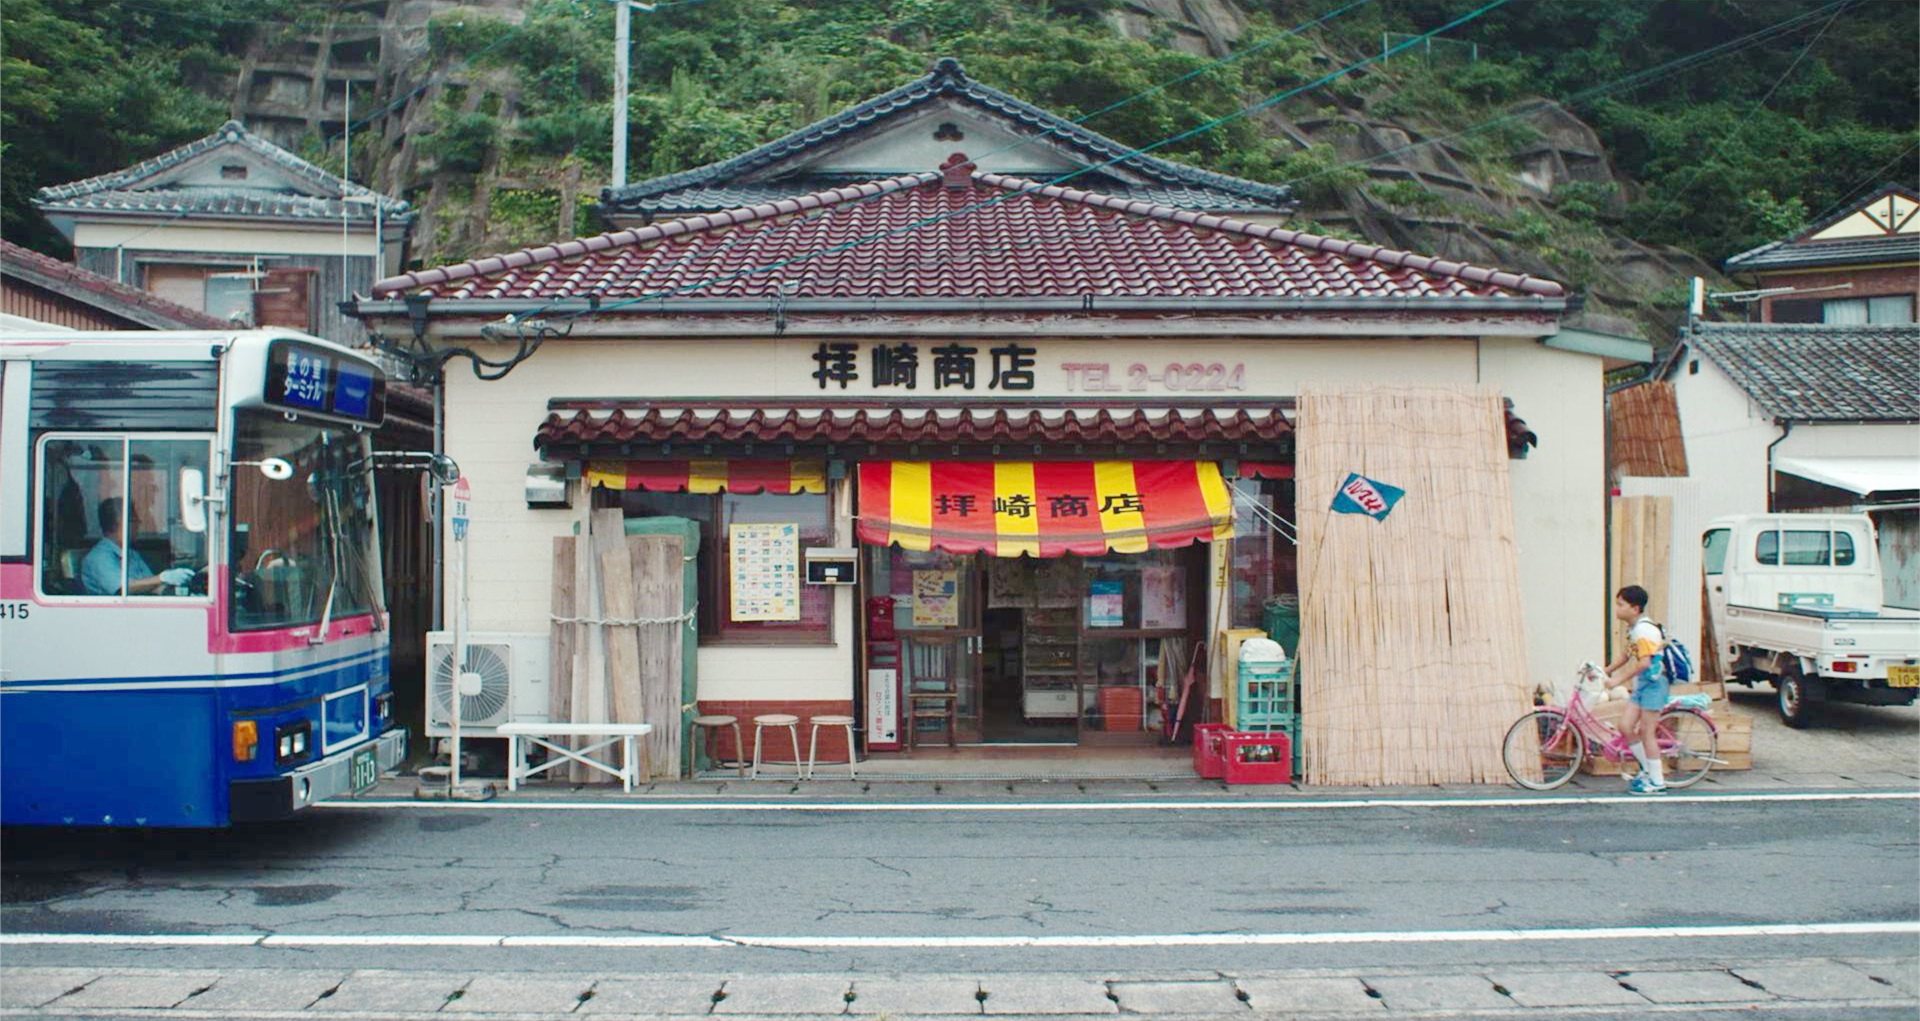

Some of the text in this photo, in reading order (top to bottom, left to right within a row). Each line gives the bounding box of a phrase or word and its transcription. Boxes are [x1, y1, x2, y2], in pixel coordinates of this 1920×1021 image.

[812, 342, 1038, 391] 拝崎商店
[1061, 362, 1247, 392] TEL 2-0224
[283, 375, 322, 401] ターミナル
[934, 493, 1145, 518] 拝崎商店
